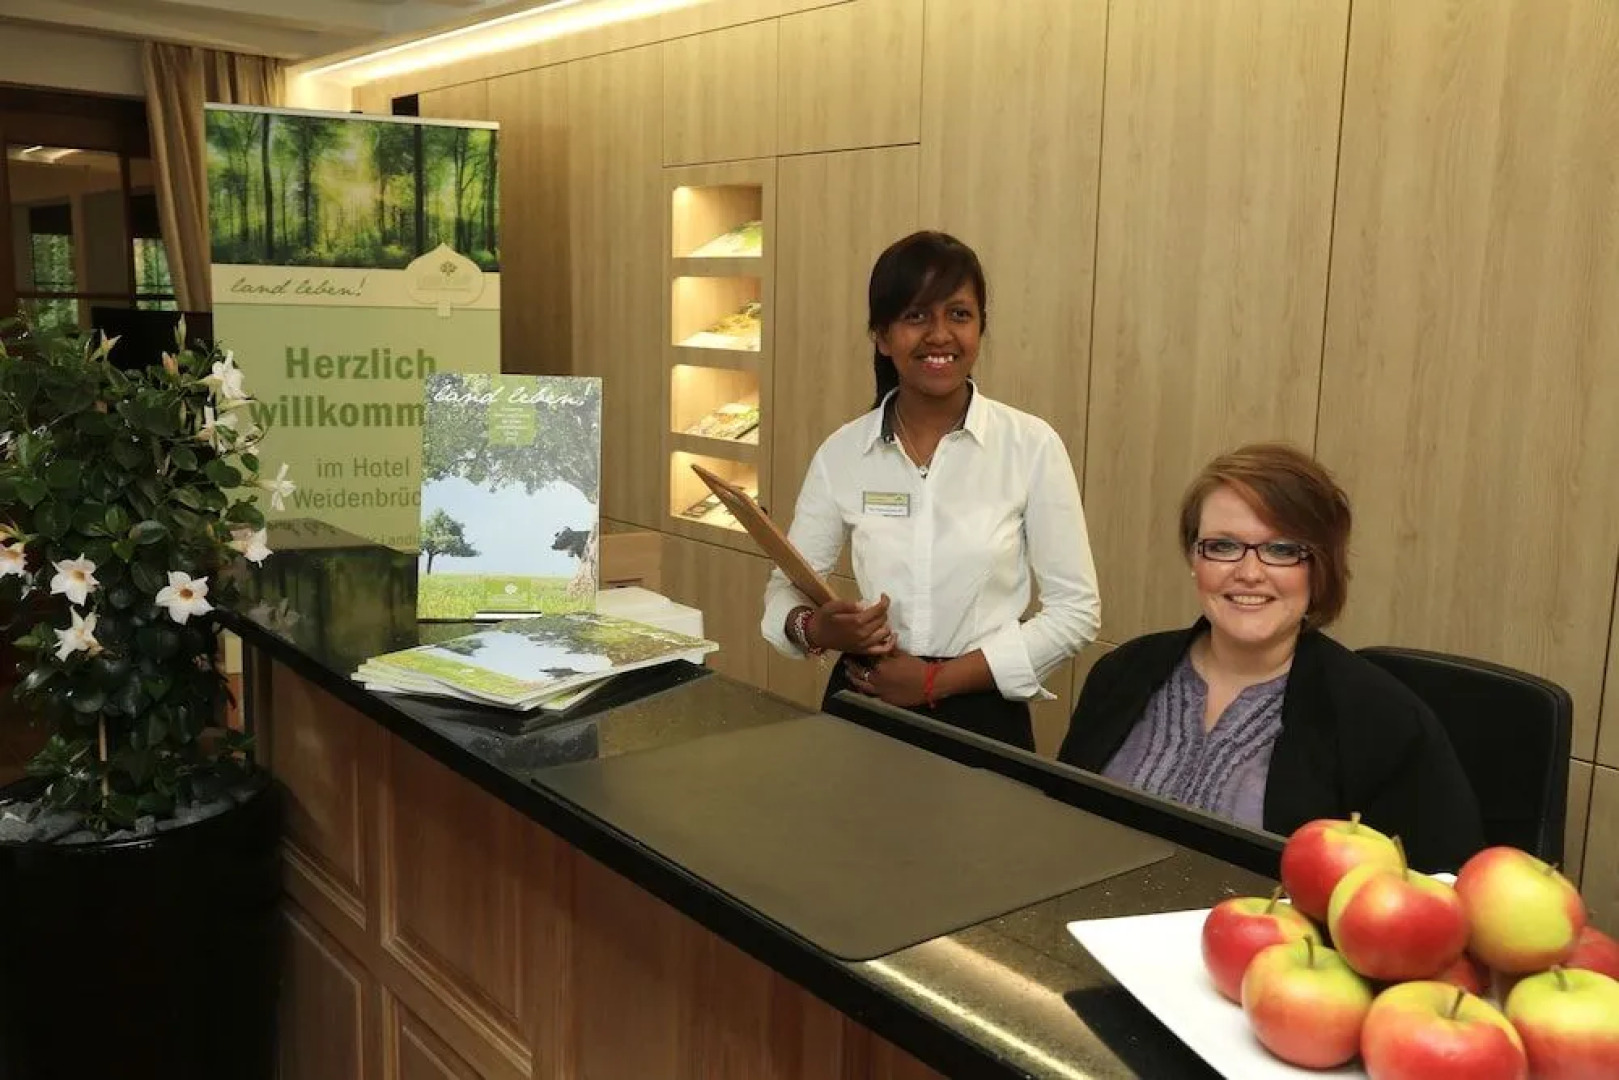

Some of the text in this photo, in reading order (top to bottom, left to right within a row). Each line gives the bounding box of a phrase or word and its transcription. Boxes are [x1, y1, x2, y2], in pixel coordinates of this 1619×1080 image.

[230, 276, 292, 294] land
[285, 347, 436, 379] Herzlich
[433, 384, 505, 404] land
[249, 395, 425, 427] willkomm
[318, 457, 410, 478] im Hotel
